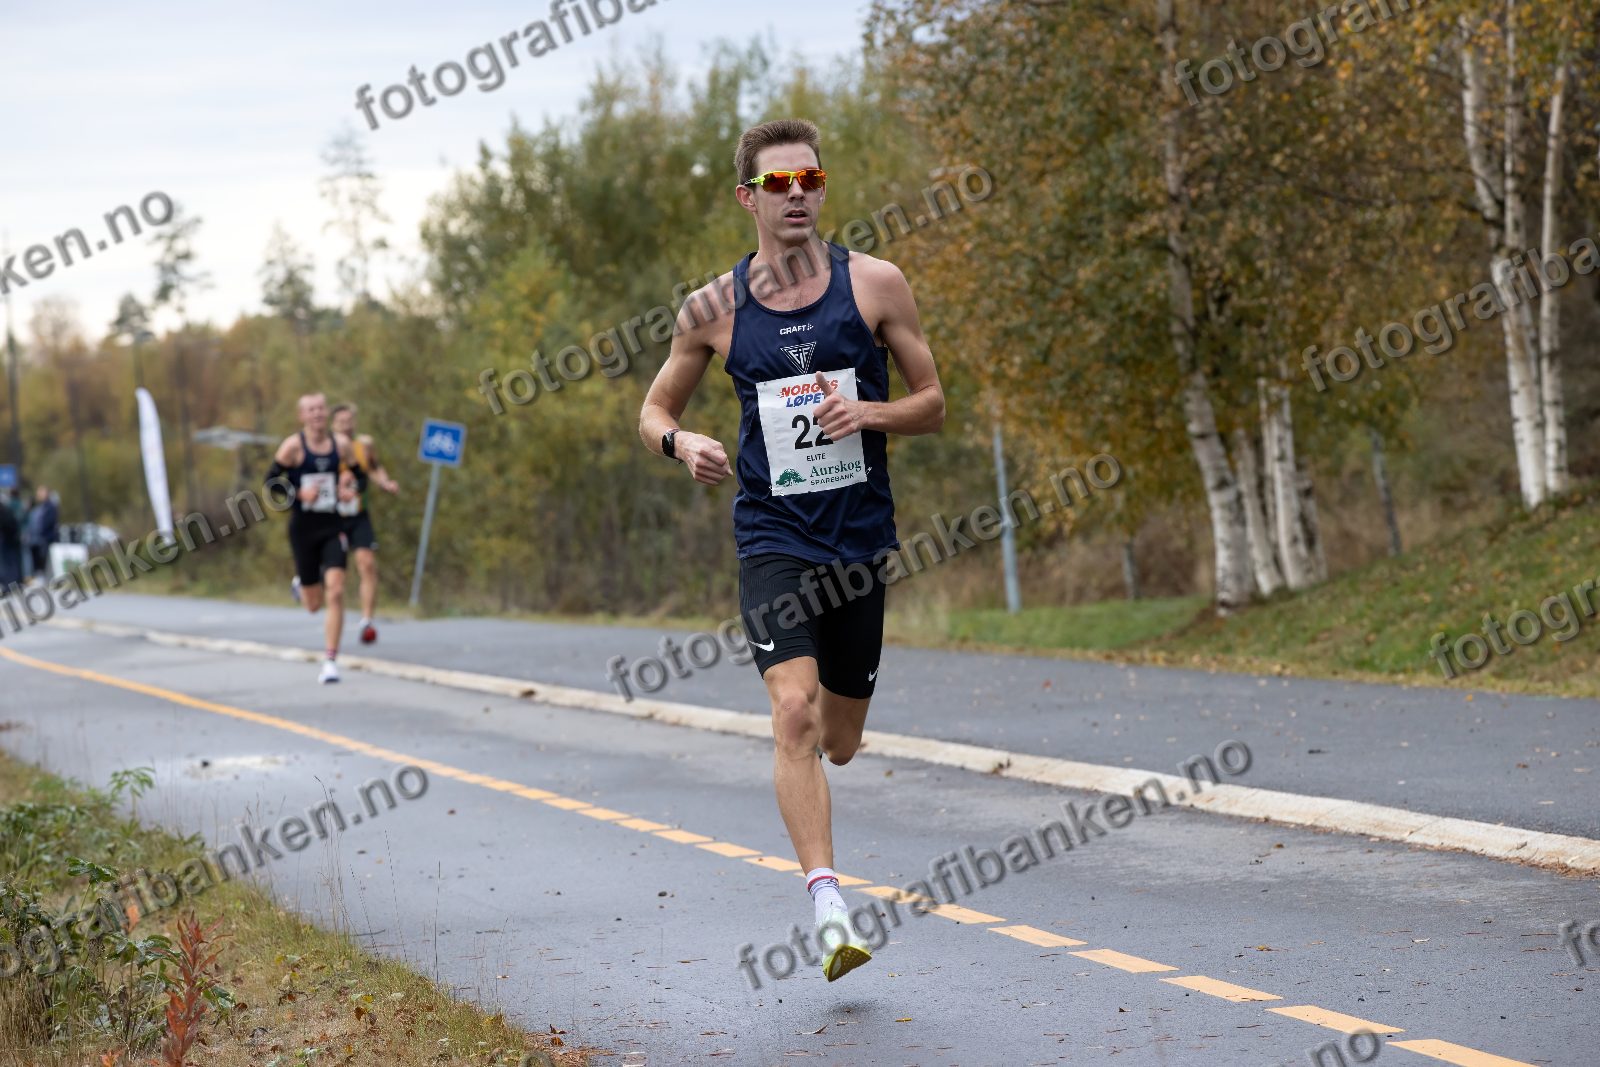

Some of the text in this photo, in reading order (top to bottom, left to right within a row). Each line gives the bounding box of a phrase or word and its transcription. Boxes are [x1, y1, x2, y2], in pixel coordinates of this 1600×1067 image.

[779, 324, 807, 335] CRAFT
[780, 379, 839, 397] NORGS
[806, 452, 827, 462] ELITE
[810, 460, 862, 478] Aurskog
[810, 473, 855, 486] SPAREBANK
